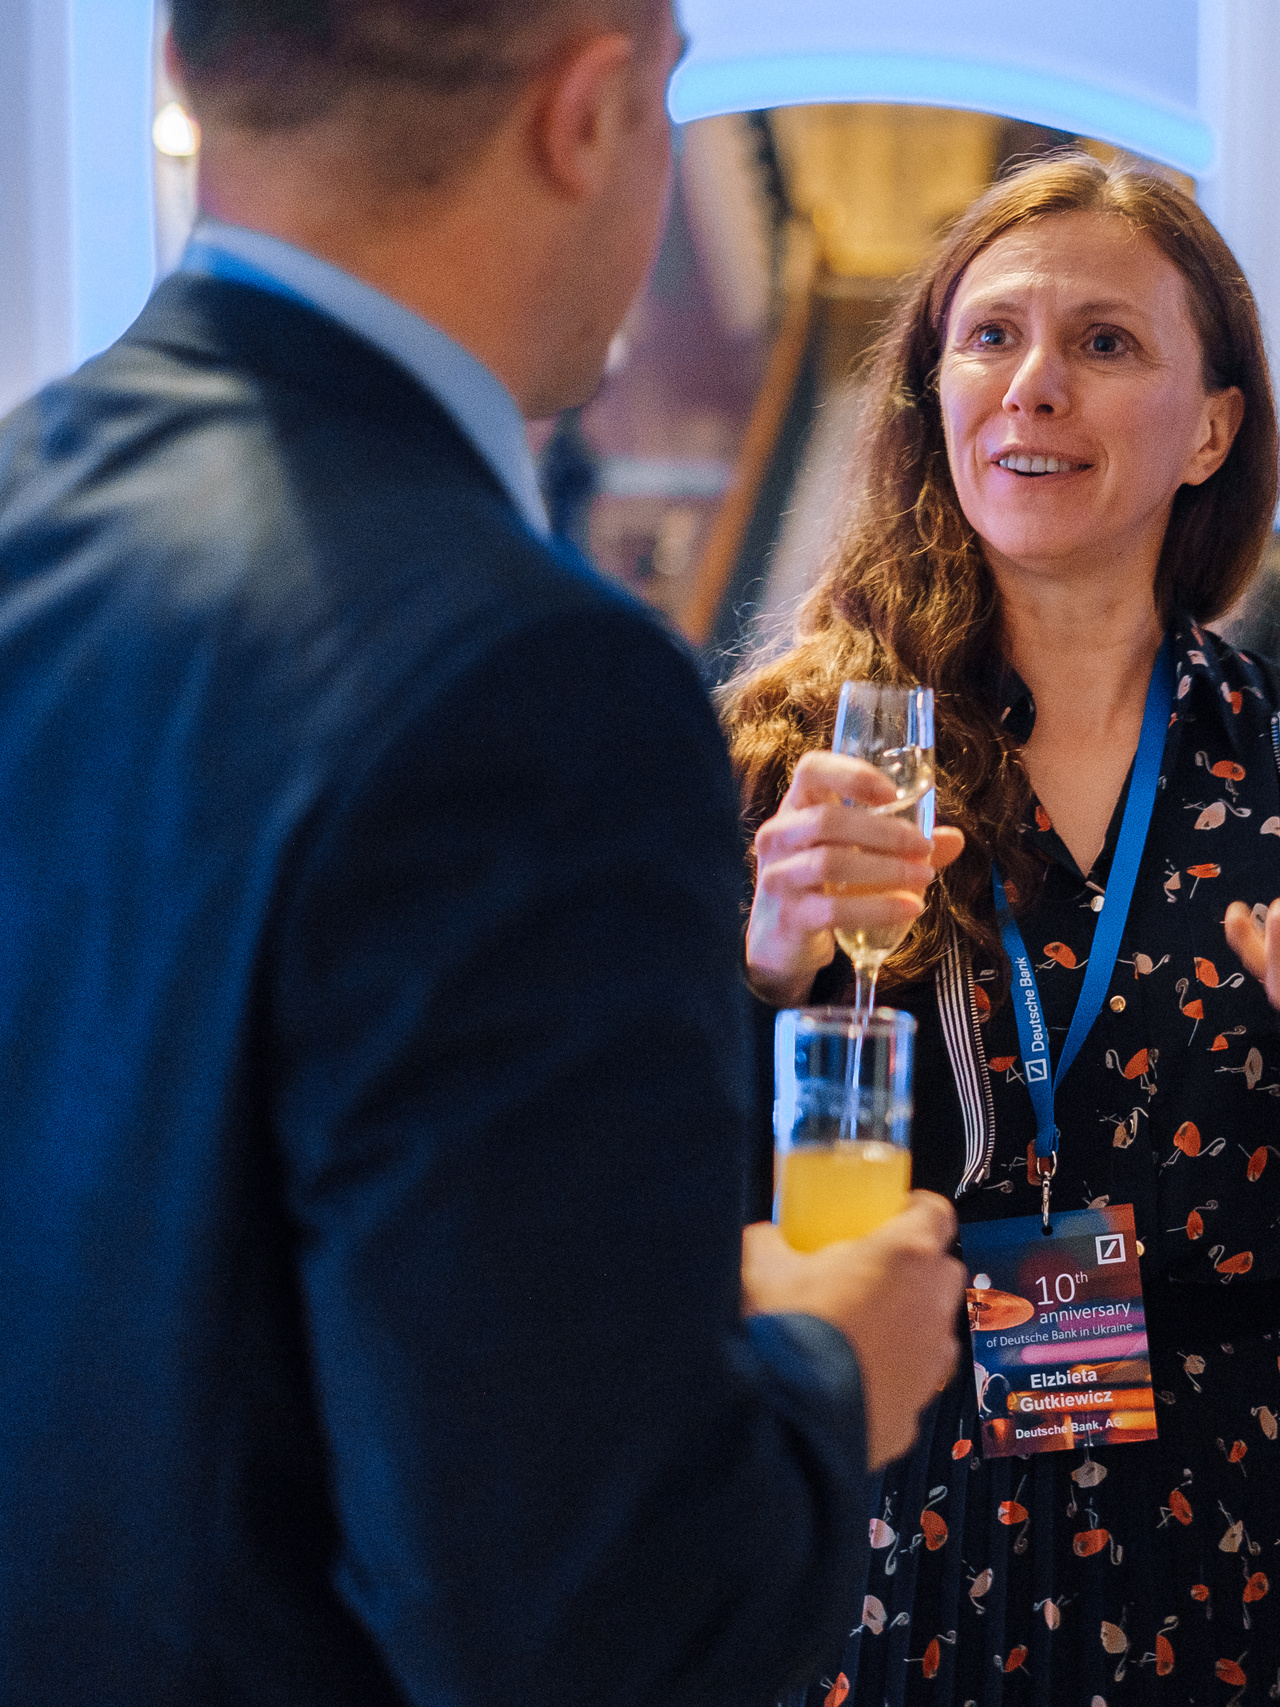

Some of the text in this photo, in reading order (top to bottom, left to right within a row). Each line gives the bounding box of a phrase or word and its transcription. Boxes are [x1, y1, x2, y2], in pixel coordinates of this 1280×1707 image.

[1014, 956, 1045, 1052] Deutsche Bank
[1039, 1302, 1131, 1324] anniversary
[986, 1322, 1133, 1348] of Deutsche Bank in Ukraine
[1030, 1368, 1098, 1389] Elzbieta
[1019, 1389, 1113, 1412] Gutkiewicz
[1015, 1417, 1123, 1439] Deutsche Bank, AG
